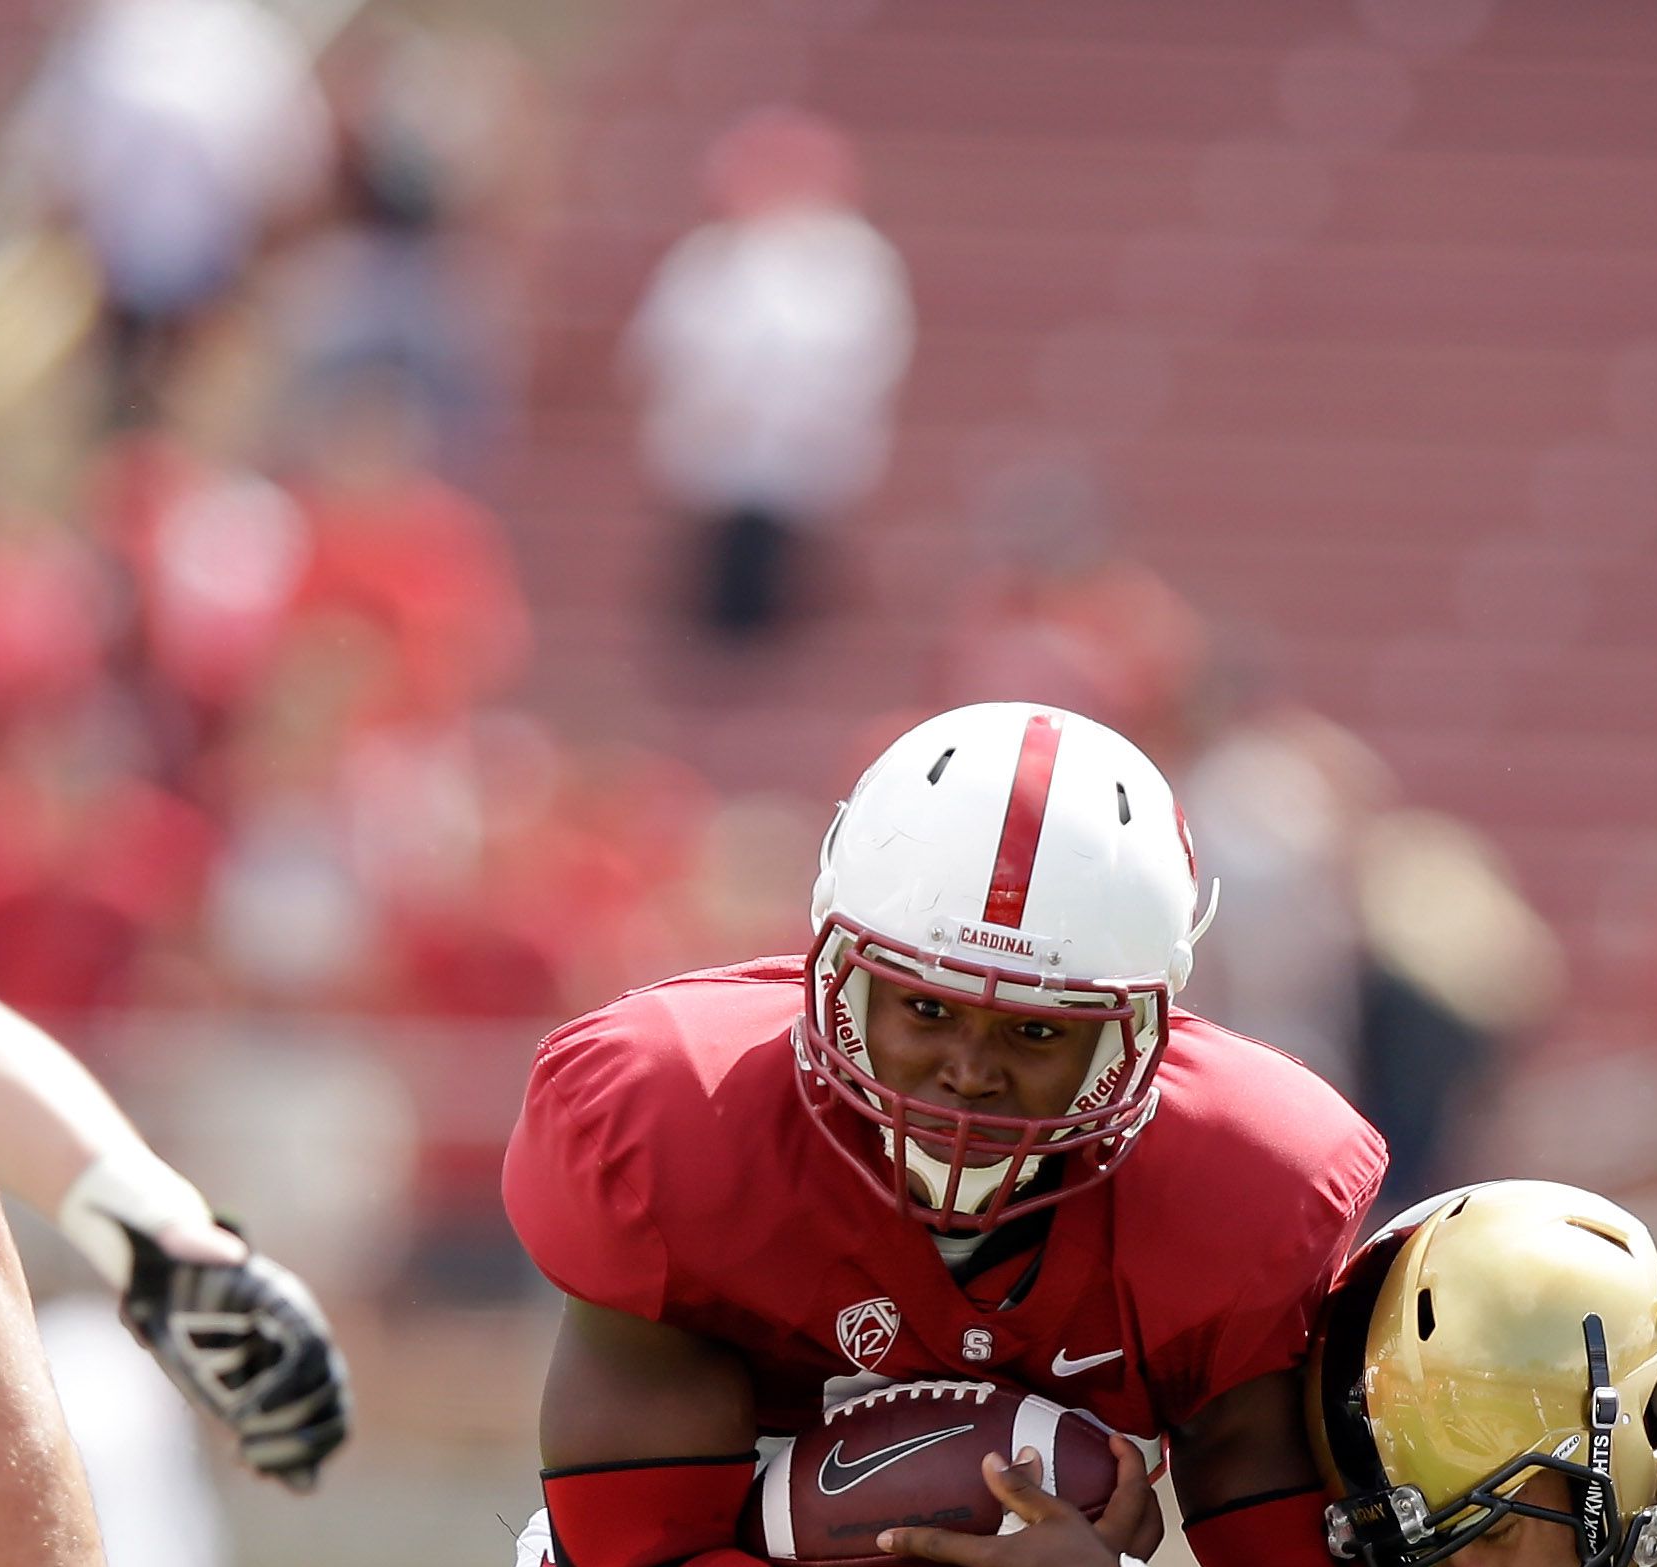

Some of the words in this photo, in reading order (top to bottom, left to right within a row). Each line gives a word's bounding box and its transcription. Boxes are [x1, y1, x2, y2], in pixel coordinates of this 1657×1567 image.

[961, 926, 1035, 958] CARDINAL
[841, 1301, 897, 1347] PAC
[854, 1329, 885, 1359] 12
[962, 1328, 993, 1361] S
